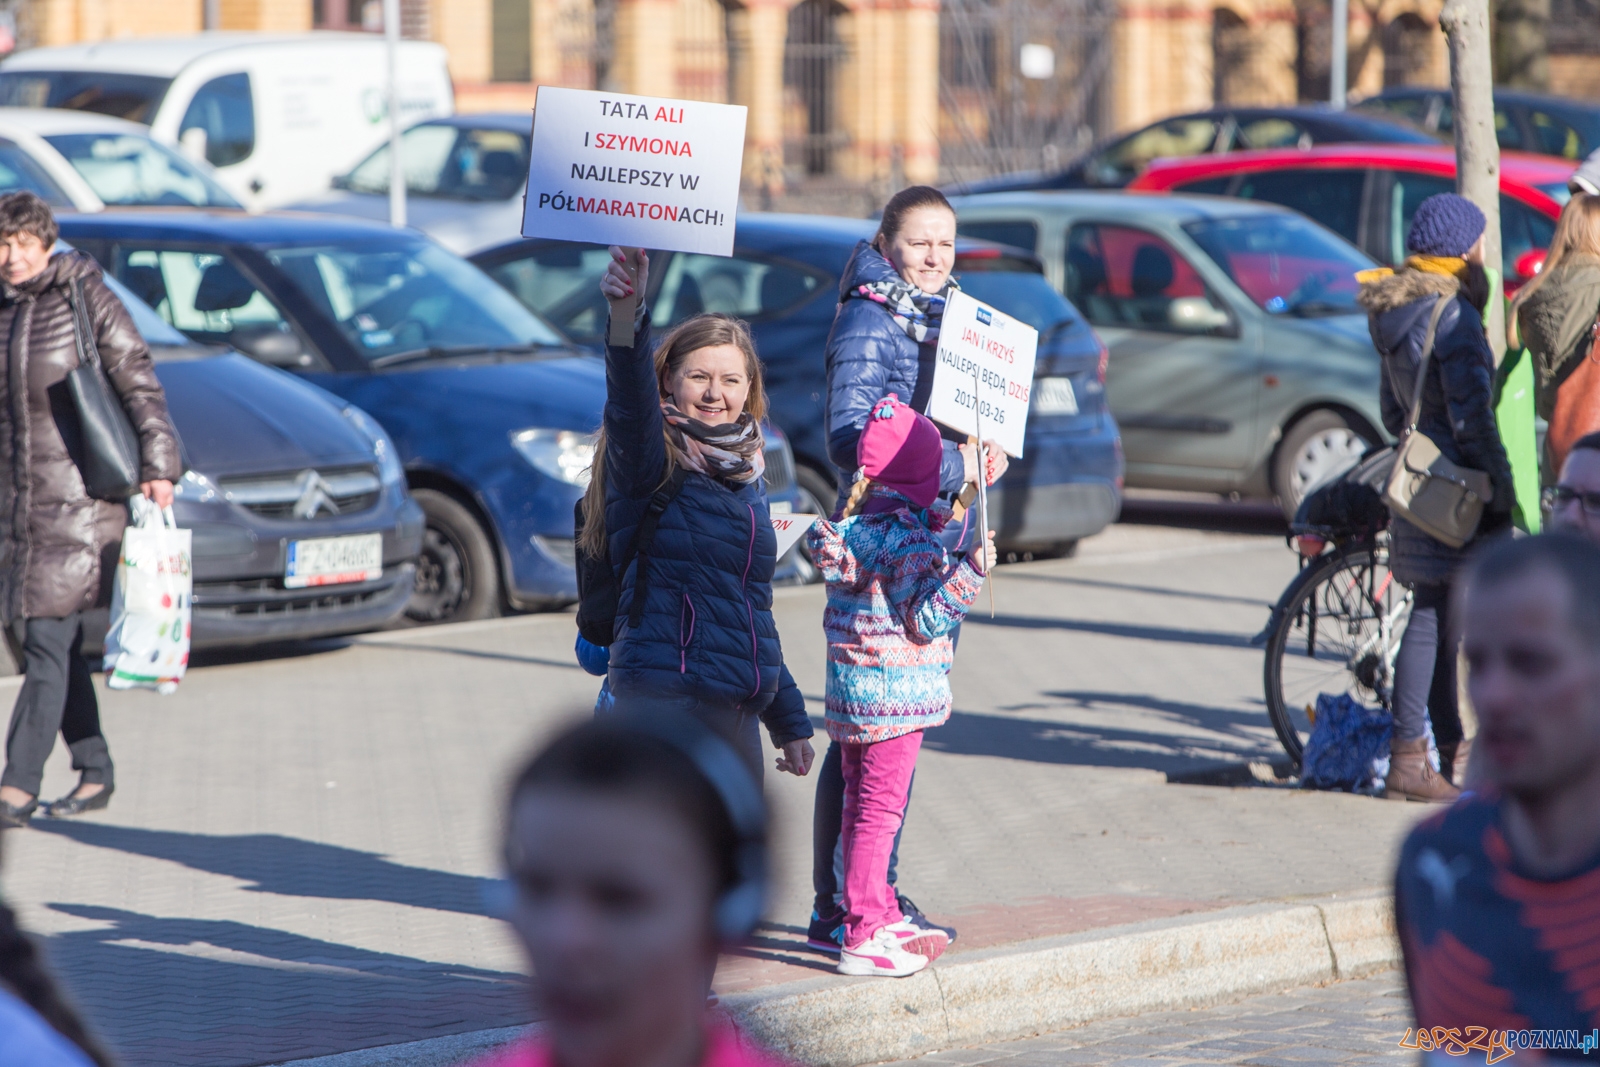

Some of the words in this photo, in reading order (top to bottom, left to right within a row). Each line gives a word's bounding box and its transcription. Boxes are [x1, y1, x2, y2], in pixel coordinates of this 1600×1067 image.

[599, 100, 649, 120] TATA
[654, 106, 684, 124] ALI
[584, 131, 590, 147] I
[594, 132, 693, 157] SZYMONA
[571, 163, 674, 188] NAJLEPSZY
[679, 174, 700, 190] W
[538, 190, 725, 226] PÓŁMARATONACH!
[962, 328, 980, 347] JAN
[981, 335, 985, 350] i
[986, 338, 1015, 364] KRZYŚ
[939, 348, 980, 380] NAJLEPSI
[982, 368, 1006, 396] BĘDĄ
[1008, 381, 1030, 403] DZIŚ
[954, 388, 1005, 424] 201703-26
